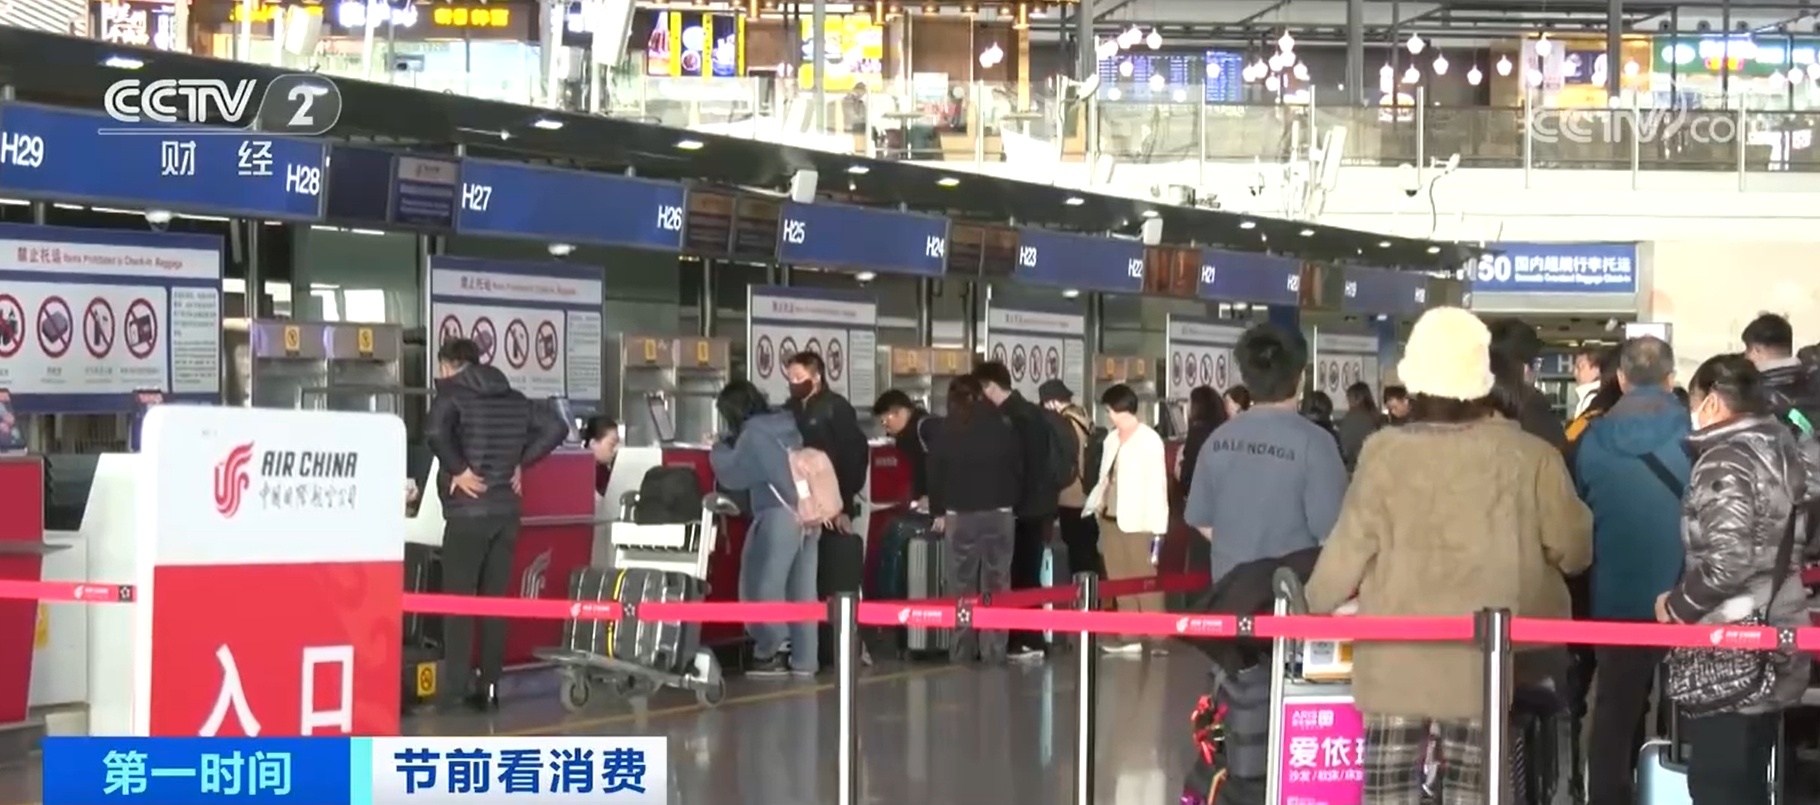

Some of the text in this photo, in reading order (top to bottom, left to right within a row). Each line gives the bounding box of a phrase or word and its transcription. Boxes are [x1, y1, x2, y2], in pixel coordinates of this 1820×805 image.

[1, 131, 44, 168] H29
[286, 163, 320, 196] H28
[462, 183, 492, 212] H27
[657, 204, 683, 231] H26
[783, 219, 806, 244] H25
[926, 235, 945, 258] H24
[1019, 246, 1038, 268] H23
[1128, 258, 1144, 278] H22
[262, 450, 358, 478] AIR CHINA
[198, 643, 354, 737] 入口
